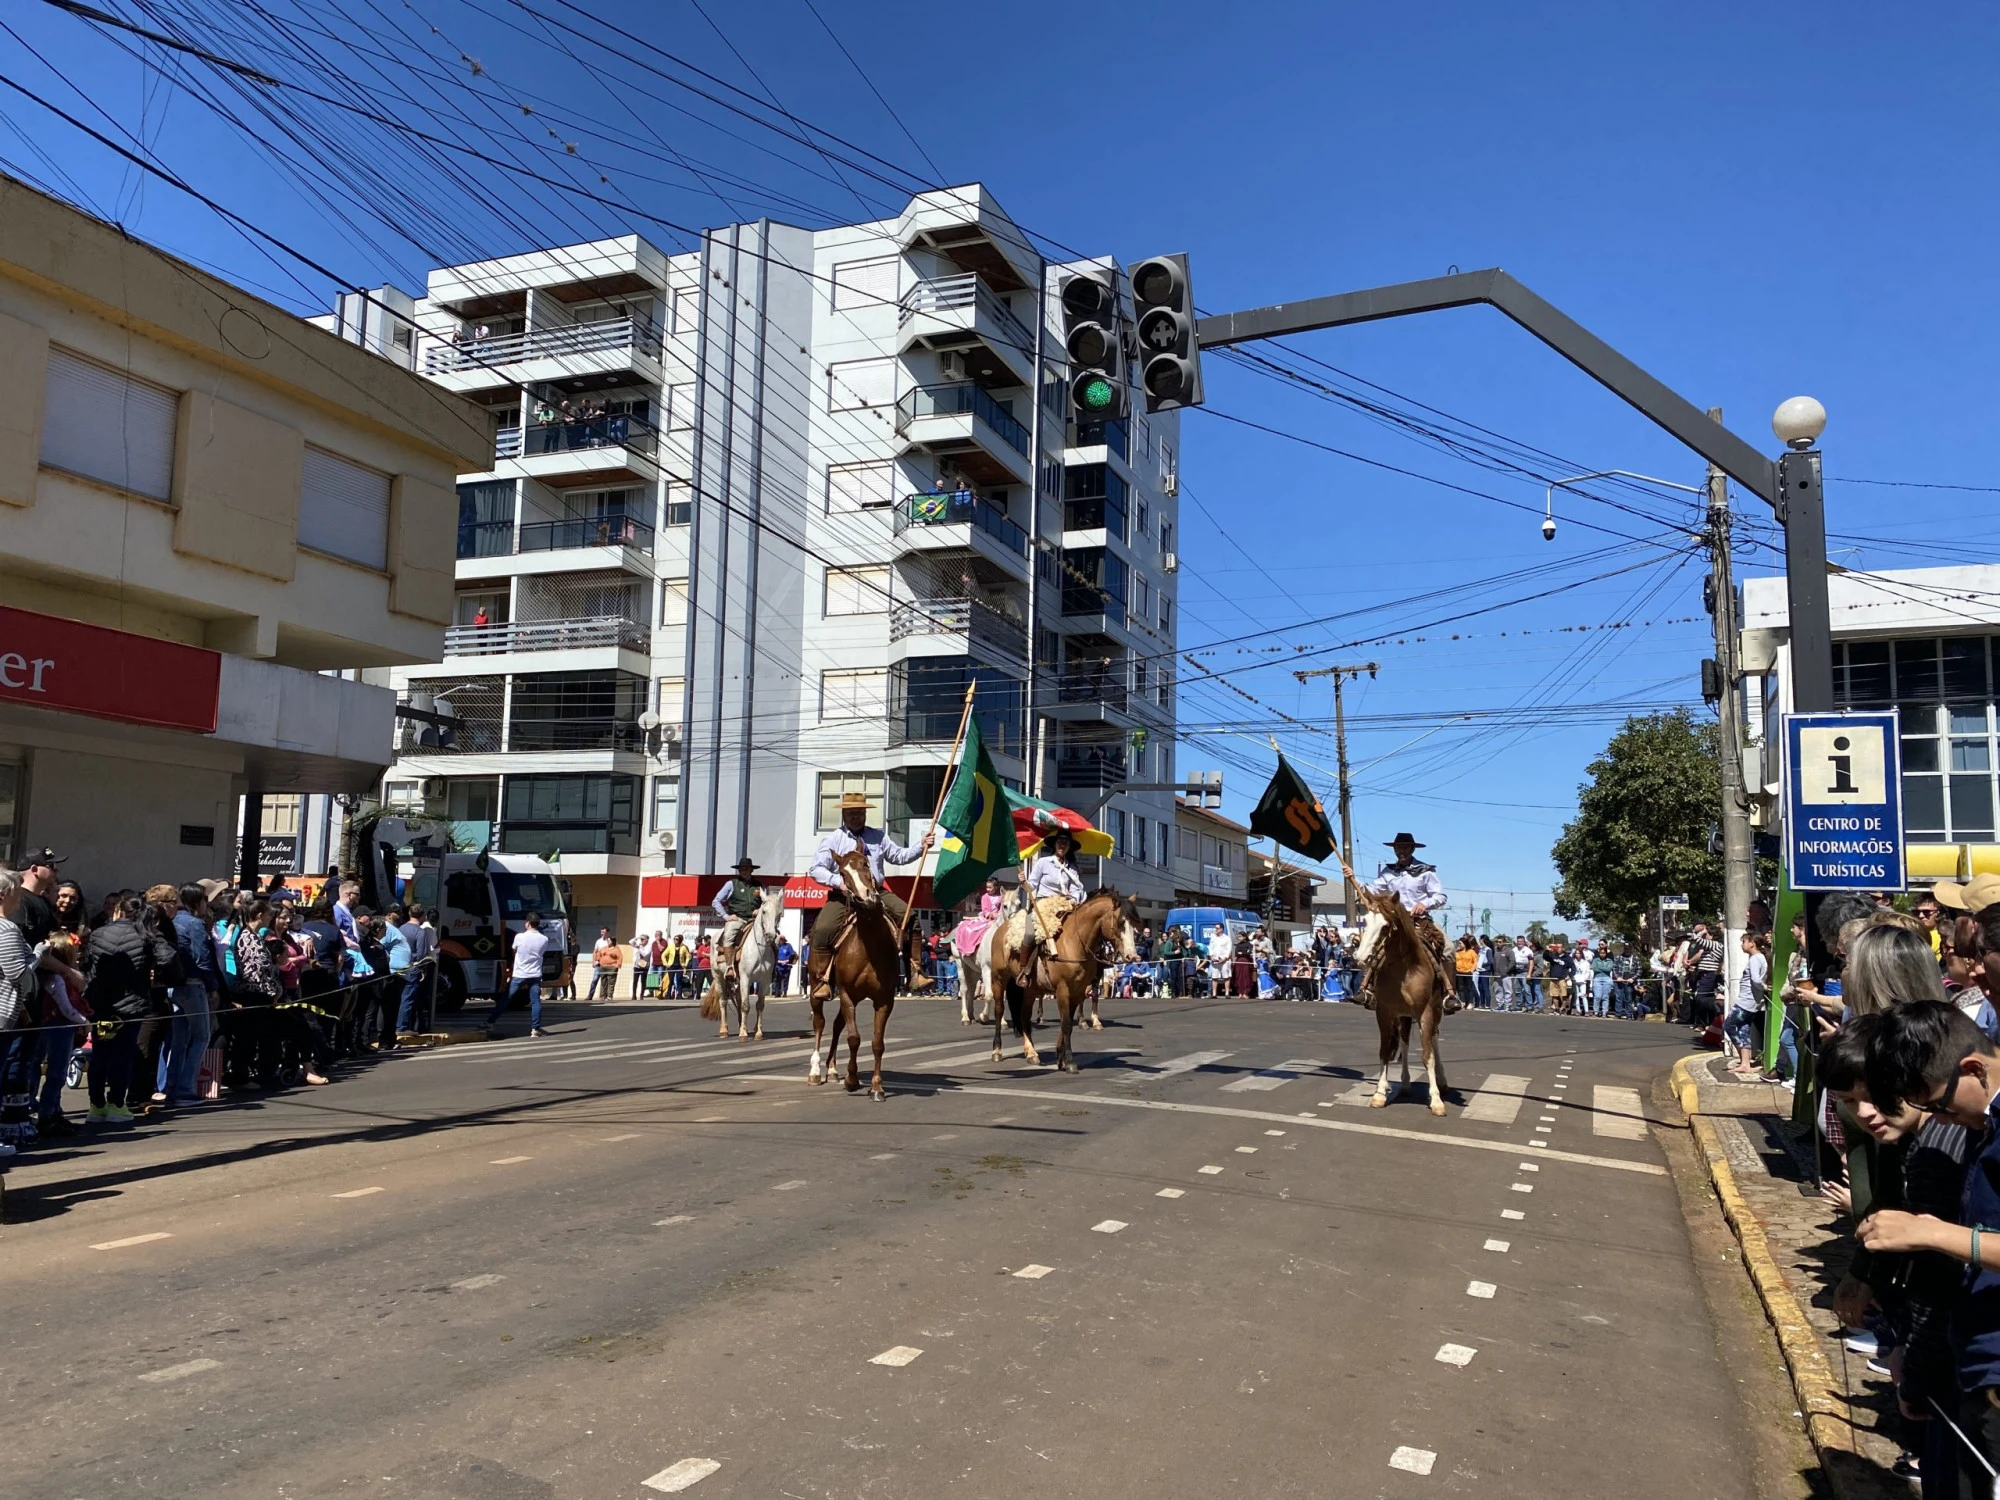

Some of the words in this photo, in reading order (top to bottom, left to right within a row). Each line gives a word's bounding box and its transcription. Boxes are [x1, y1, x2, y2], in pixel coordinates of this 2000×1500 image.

[1808, 818, 1860, 831] CENTRO
[1864, 818, 1882, 831] DE
[259, 839, 292, 852] Carolina
[1799, 838, 1893, 856] INFORMAÇÕES
[1811, 861, 1885, 877] TURÍSTICAS
